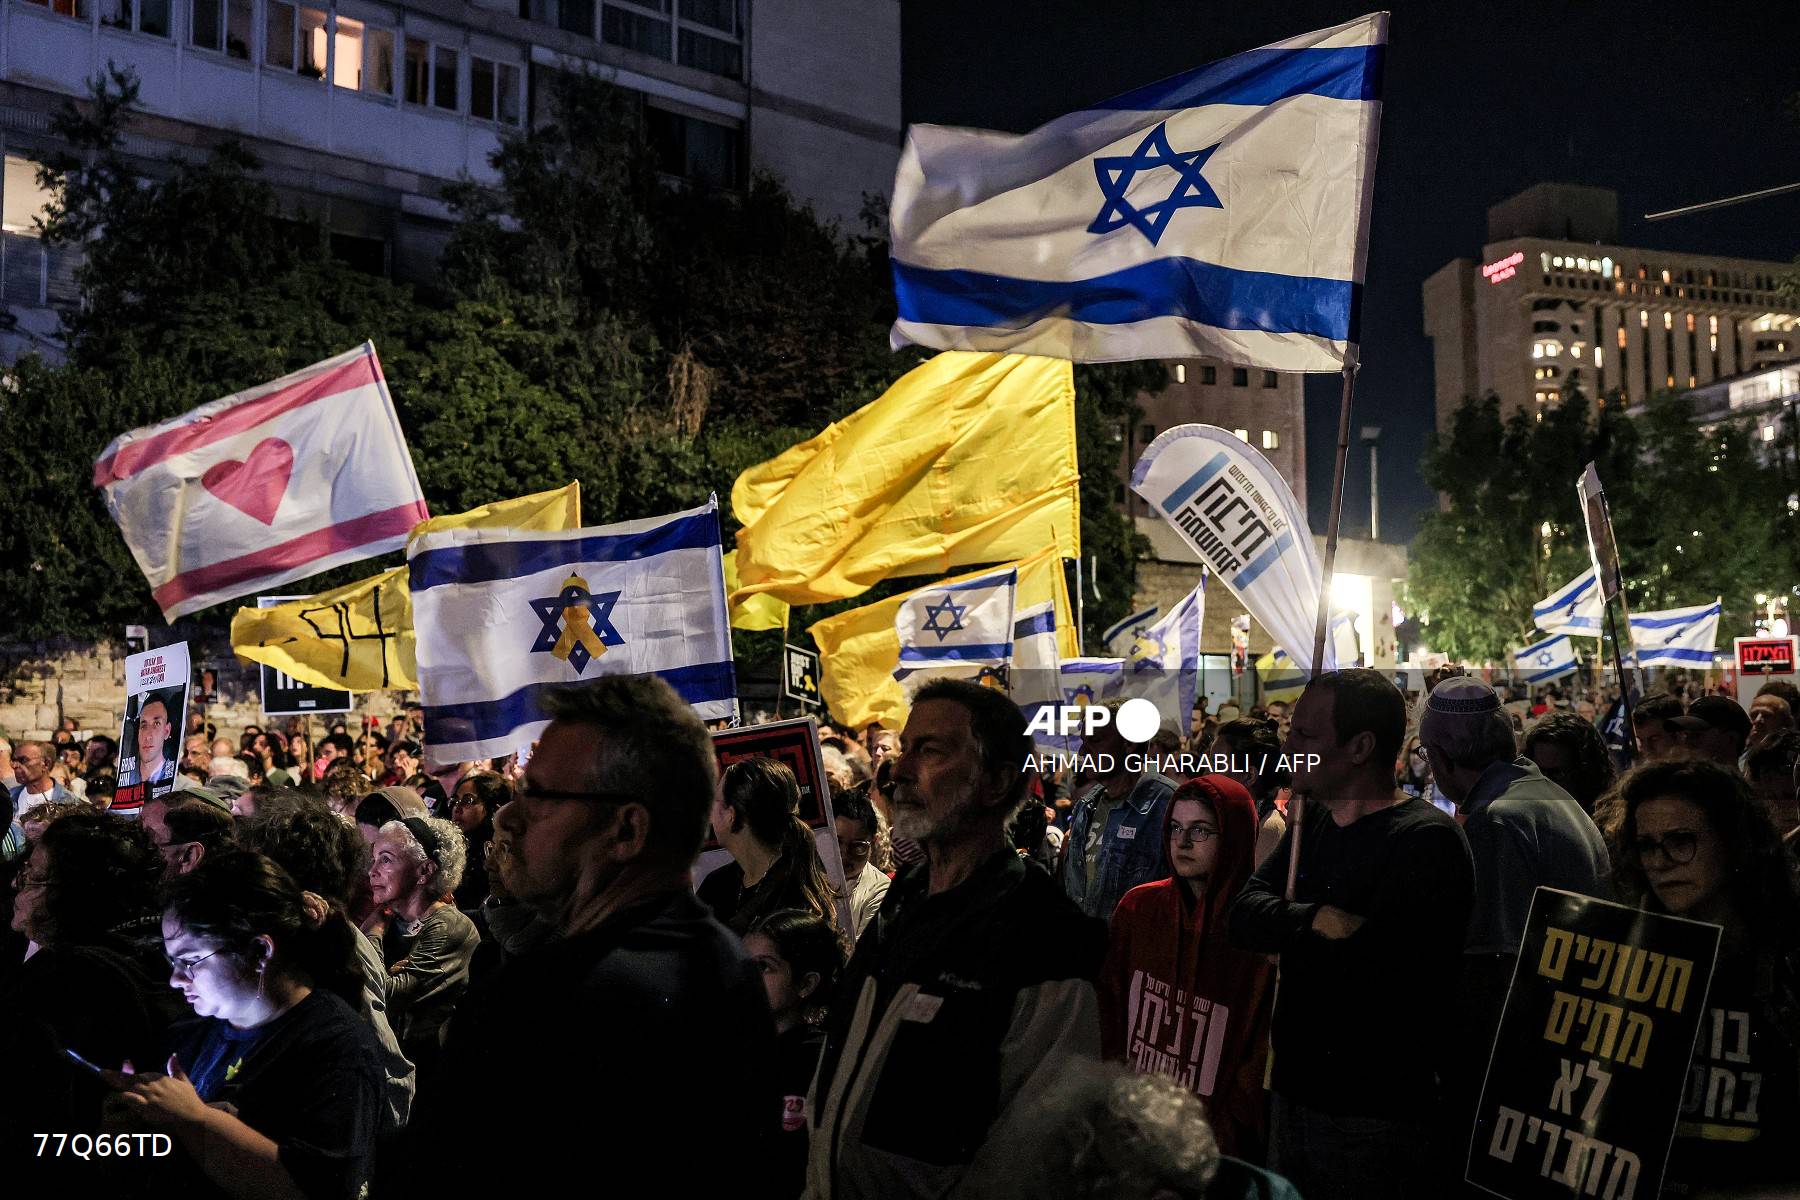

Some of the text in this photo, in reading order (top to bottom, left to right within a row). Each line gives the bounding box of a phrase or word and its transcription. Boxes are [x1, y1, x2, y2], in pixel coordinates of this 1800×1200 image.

[1537, 926, 1694, 1013] חטופים
[1543, 990, 1654, 1069] מתים
[1548, 1057, 1613, 1123] לא
[1488, 1105, 1642, 1200] מדברים
